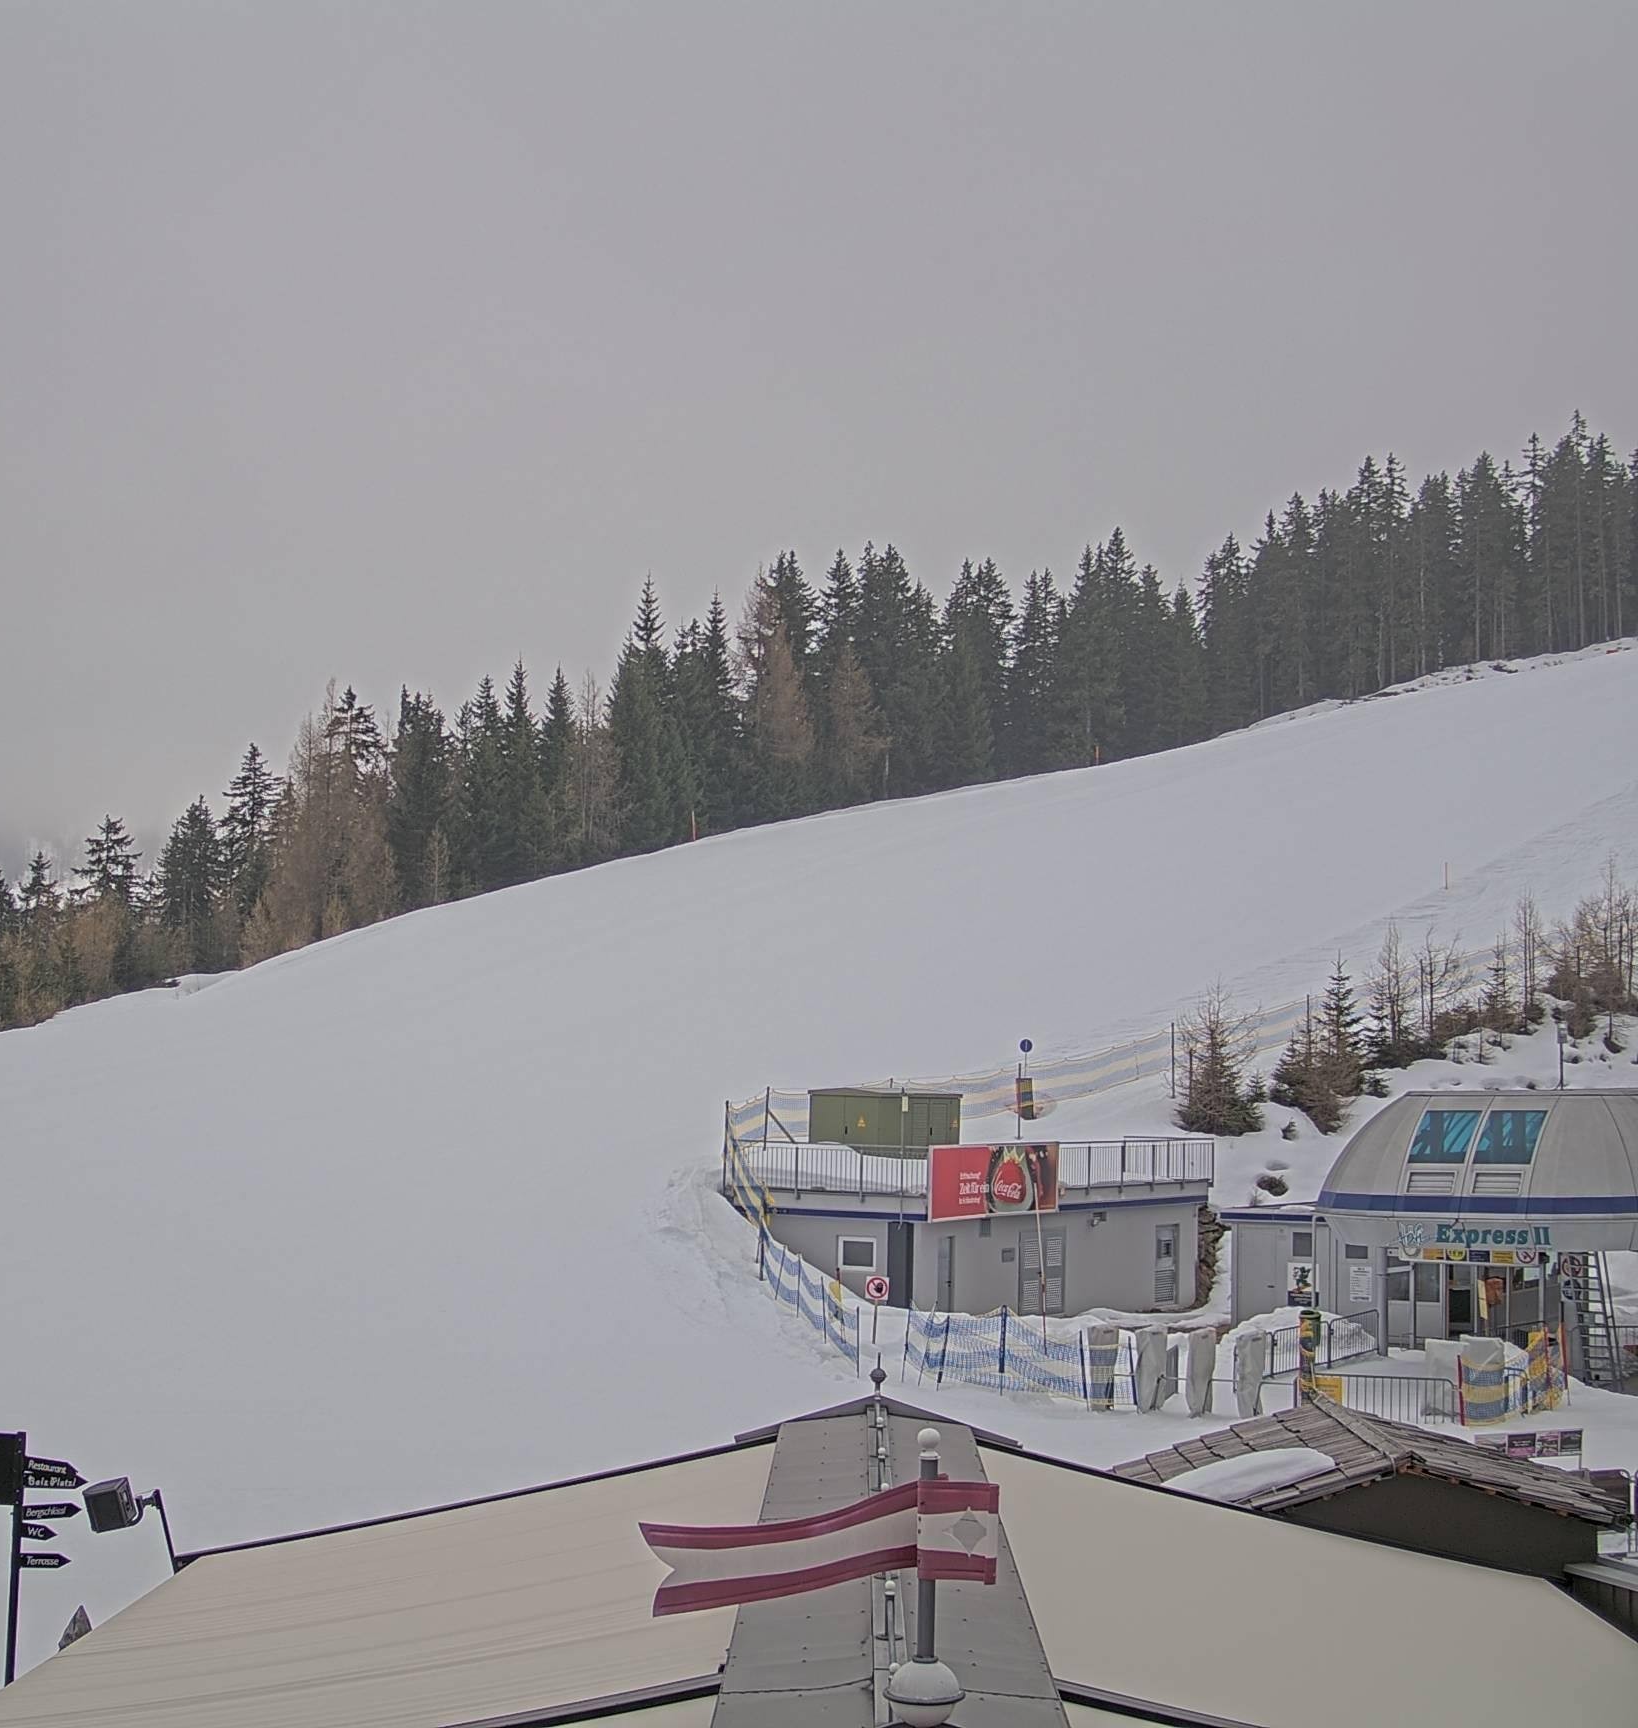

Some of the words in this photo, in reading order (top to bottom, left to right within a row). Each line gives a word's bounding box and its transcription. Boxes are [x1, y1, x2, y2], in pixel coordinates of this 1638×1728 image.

[1436, 1223, 1528, 1248] Express
[1532, 1226, 1551, 1245] II
[28, 1460, 67, 1474] Restaurant
[27, 1526, 46, 1537] WC
[26, 1555, 59, 1566] Terrasse
